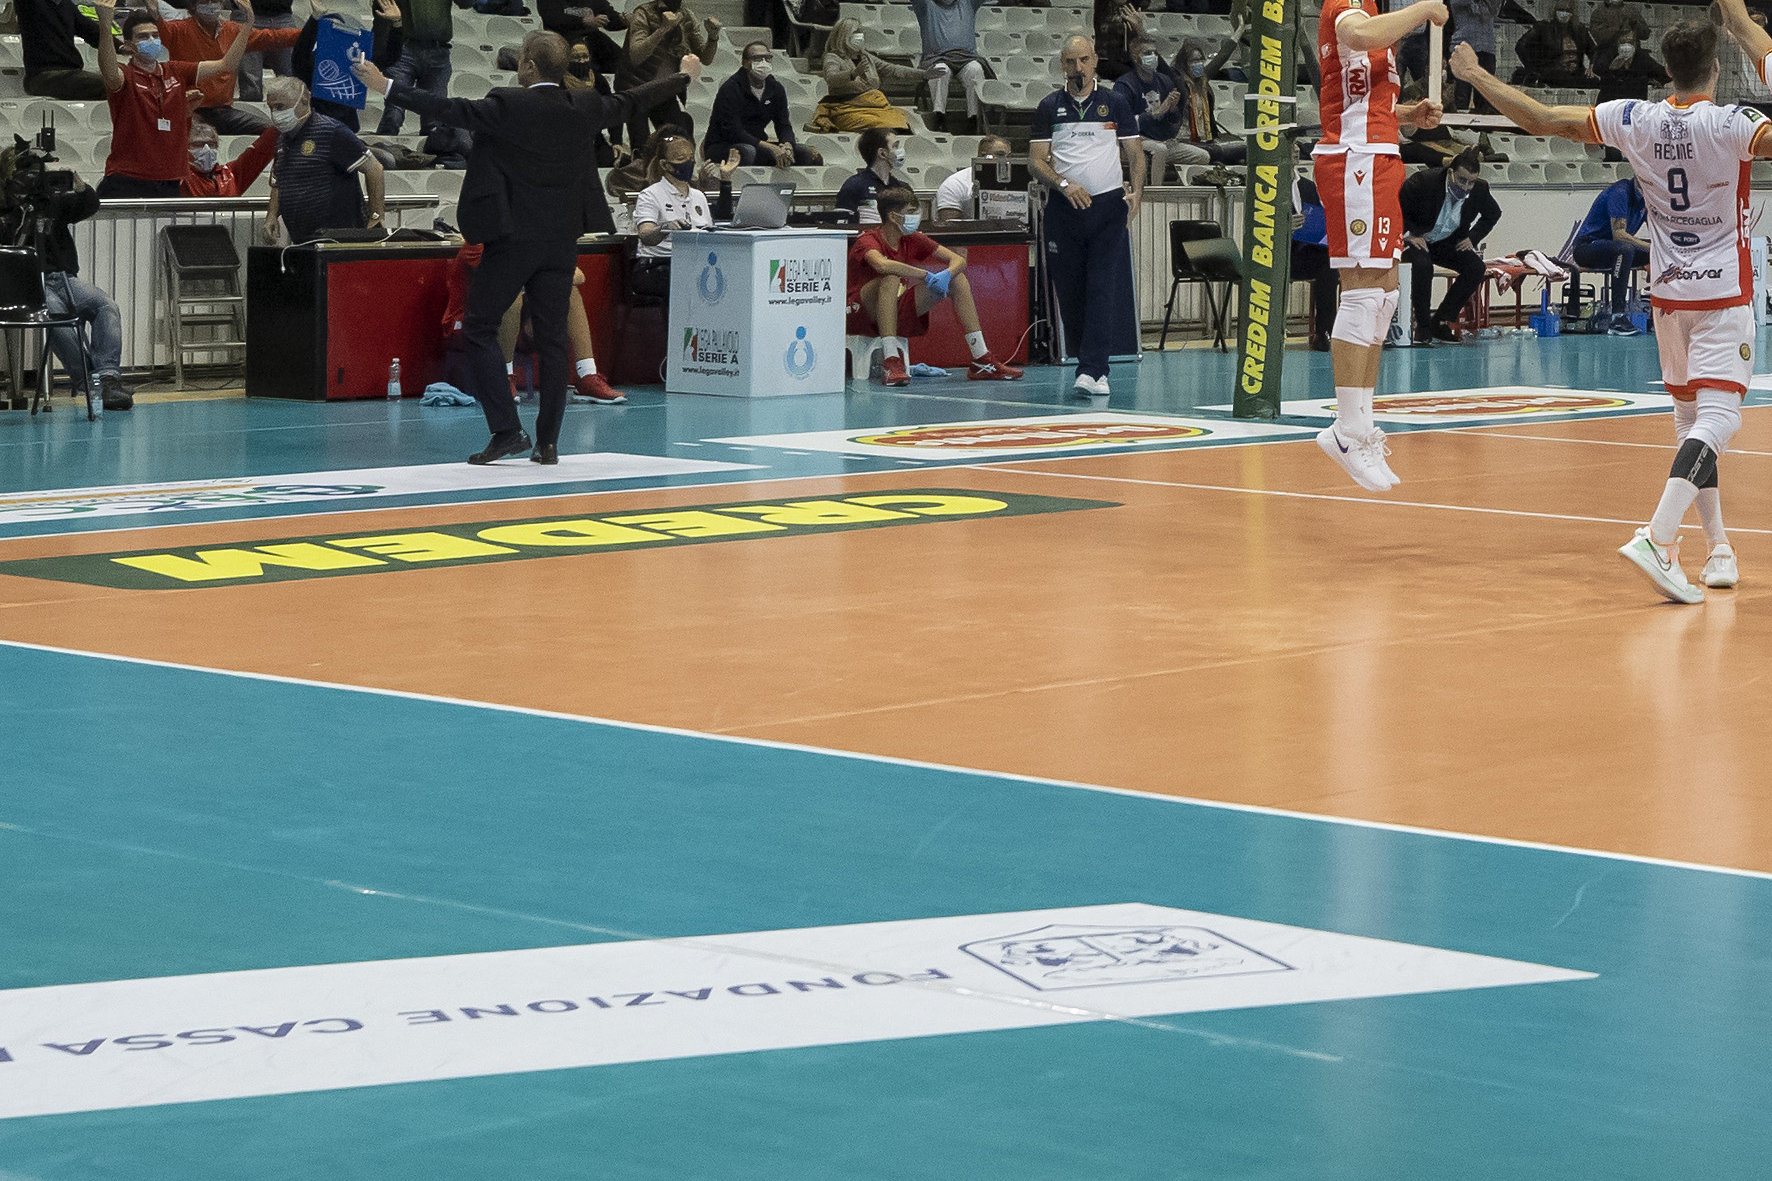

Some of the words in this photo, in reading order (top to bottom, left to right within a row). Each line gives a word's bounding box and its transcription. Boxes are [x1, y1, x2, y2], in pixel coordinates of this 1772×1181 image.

[1256, 35, 1282, 151] CREDEM
[1350, 68, 1365, 96] RM
[1654, 142, 1694, 160] RECINE
[1667, 167, 1691, 212] 9
[1251, 165, 1279, 268] BANCA
[1378, 216, 1391, 235] 13
[786, 282, 819, 293] SERIE
[822, 282, 831, 292] A
[1676, 268, 1723, 280] consar
[1241, 278, 1272, 395] CREDEM
[698, 352, 728, 364] SERIE
[730, 353, 739, 365] A
[110, 494, 1010, 583] CREDEM
[397, 967, 955, 1026] FONDAZIONE
[43, 1018, 365, 1056] CASSA
